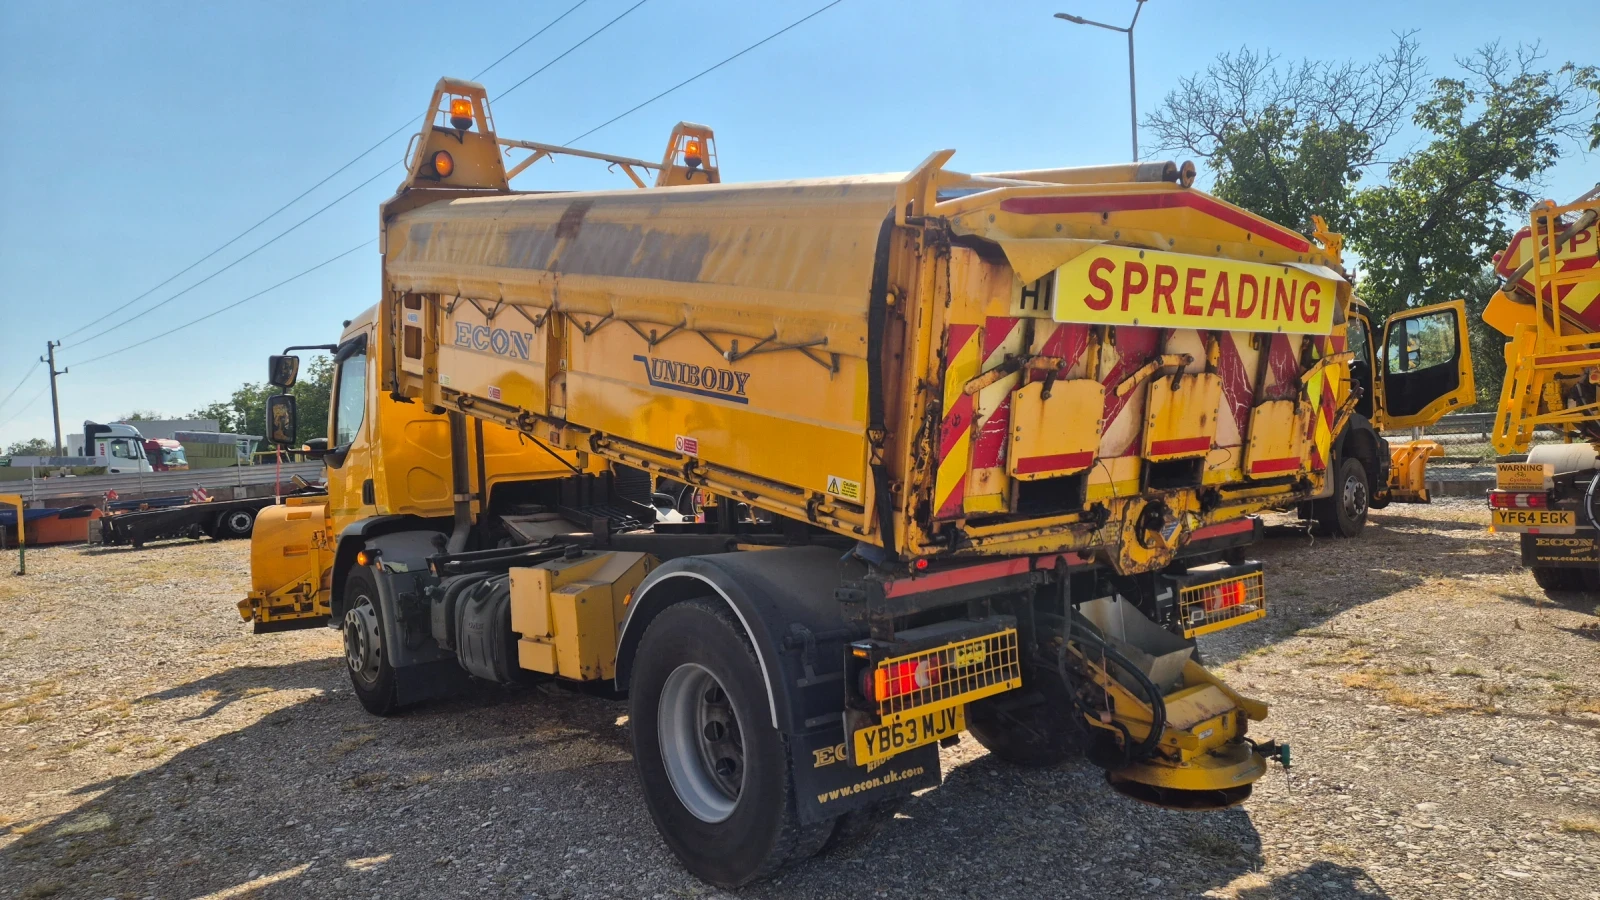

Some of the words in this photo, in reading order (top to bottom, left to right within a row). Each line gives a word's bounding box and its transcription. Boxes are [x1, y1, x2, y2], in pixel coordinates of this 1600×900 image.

[1083, 257, 1321, 324] SPREADING
[454, 321, 532, 360] ECON
[651, 357, 750, 396] UNIBODY
[1499, 464, 1543, 472] WARNING
[1499, 512, 1536, 524] YF64
[1540, 512, 1569, 524] EGK
[1535, 538, 1595, 547] ECON
[864, 719, 917, 757] YB63
[922, 705, 958, 740] MJV
[817, 766, 924, 804] www.econ.uk.com
